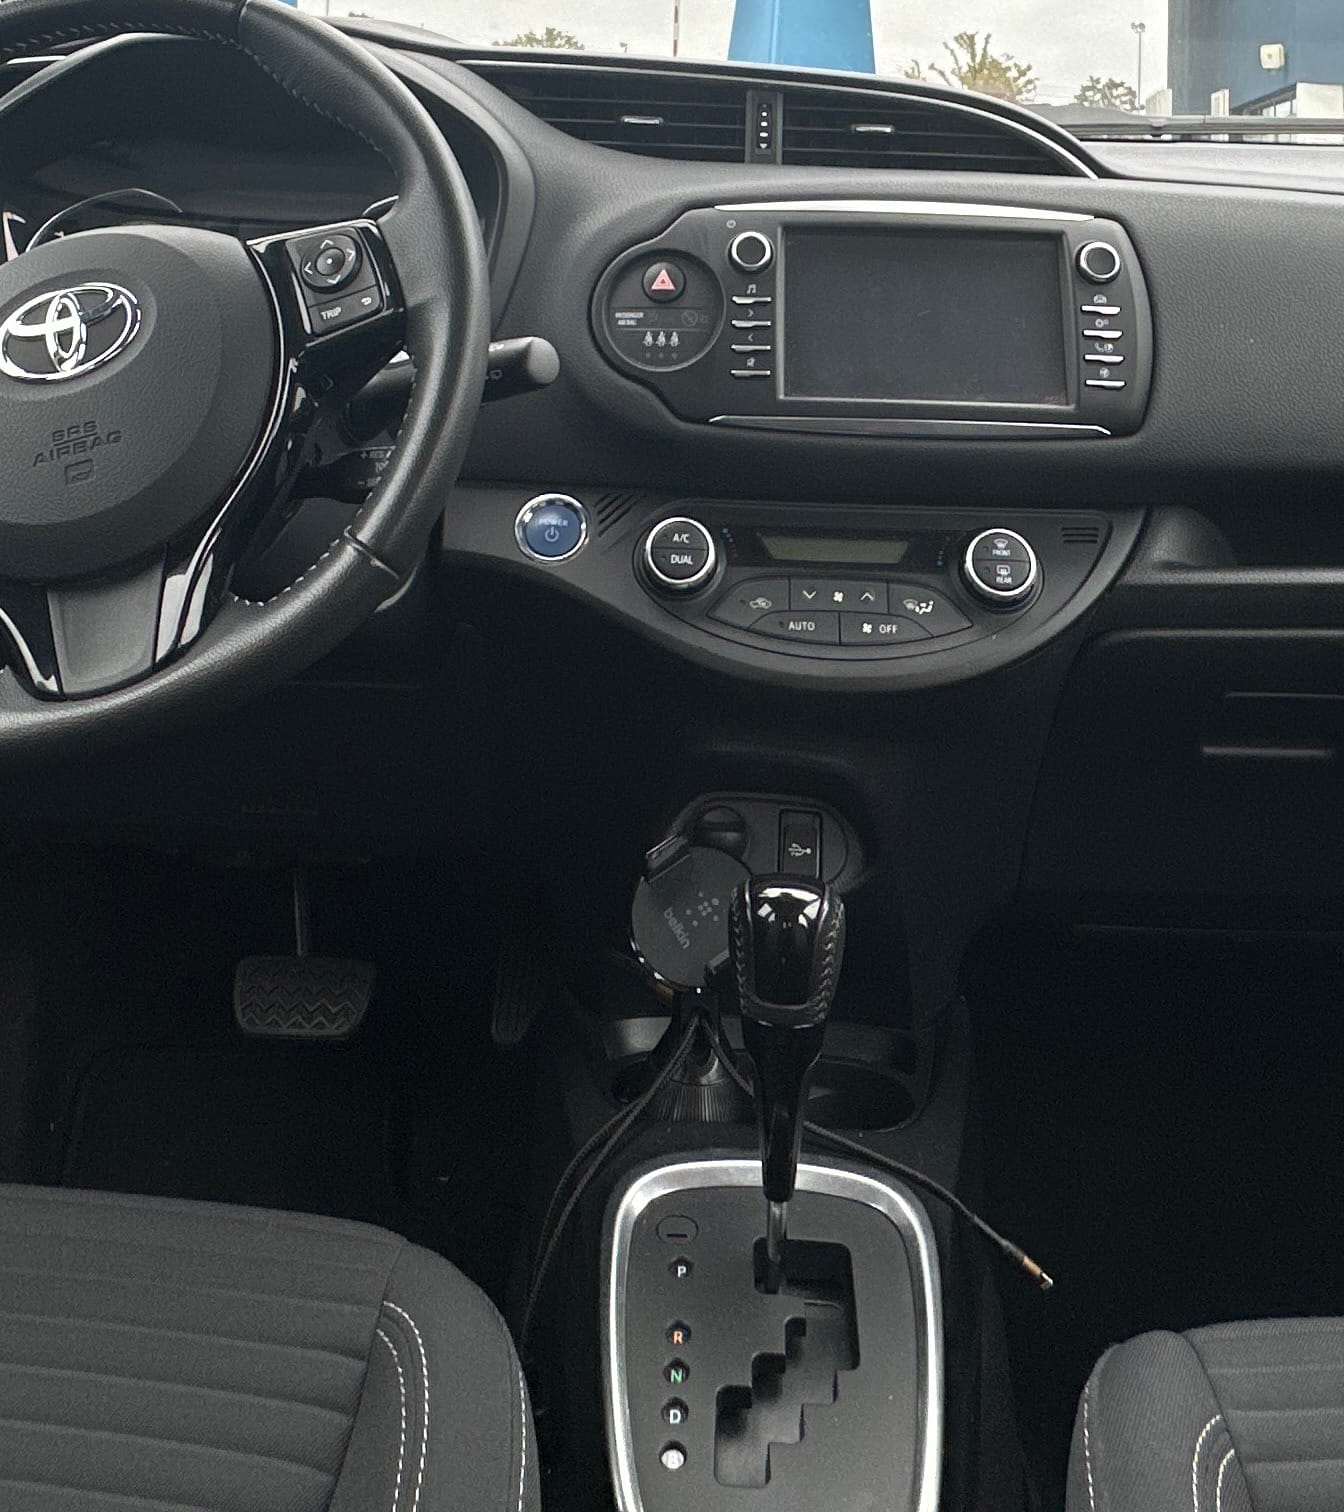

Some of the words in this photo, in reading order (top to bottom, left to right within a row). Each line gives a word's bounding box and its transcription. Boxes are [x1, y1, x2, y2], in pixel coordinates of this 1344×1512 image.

[320, 306, 342, 320] TRIP
[538, 518, 569, 527] POWER
[672, 533, 690, 544] A/C
[670, 553, 694, 566] DUAL
[788, 621, 816, 631] AUTO
[879, 624, 898, 634] OFF
[677, 1265, 687, 1278] P
[673, 1331, 683, 1344] R
[670, 1369, 683, 1384] N
[669, 1409, 681, 1424] D
